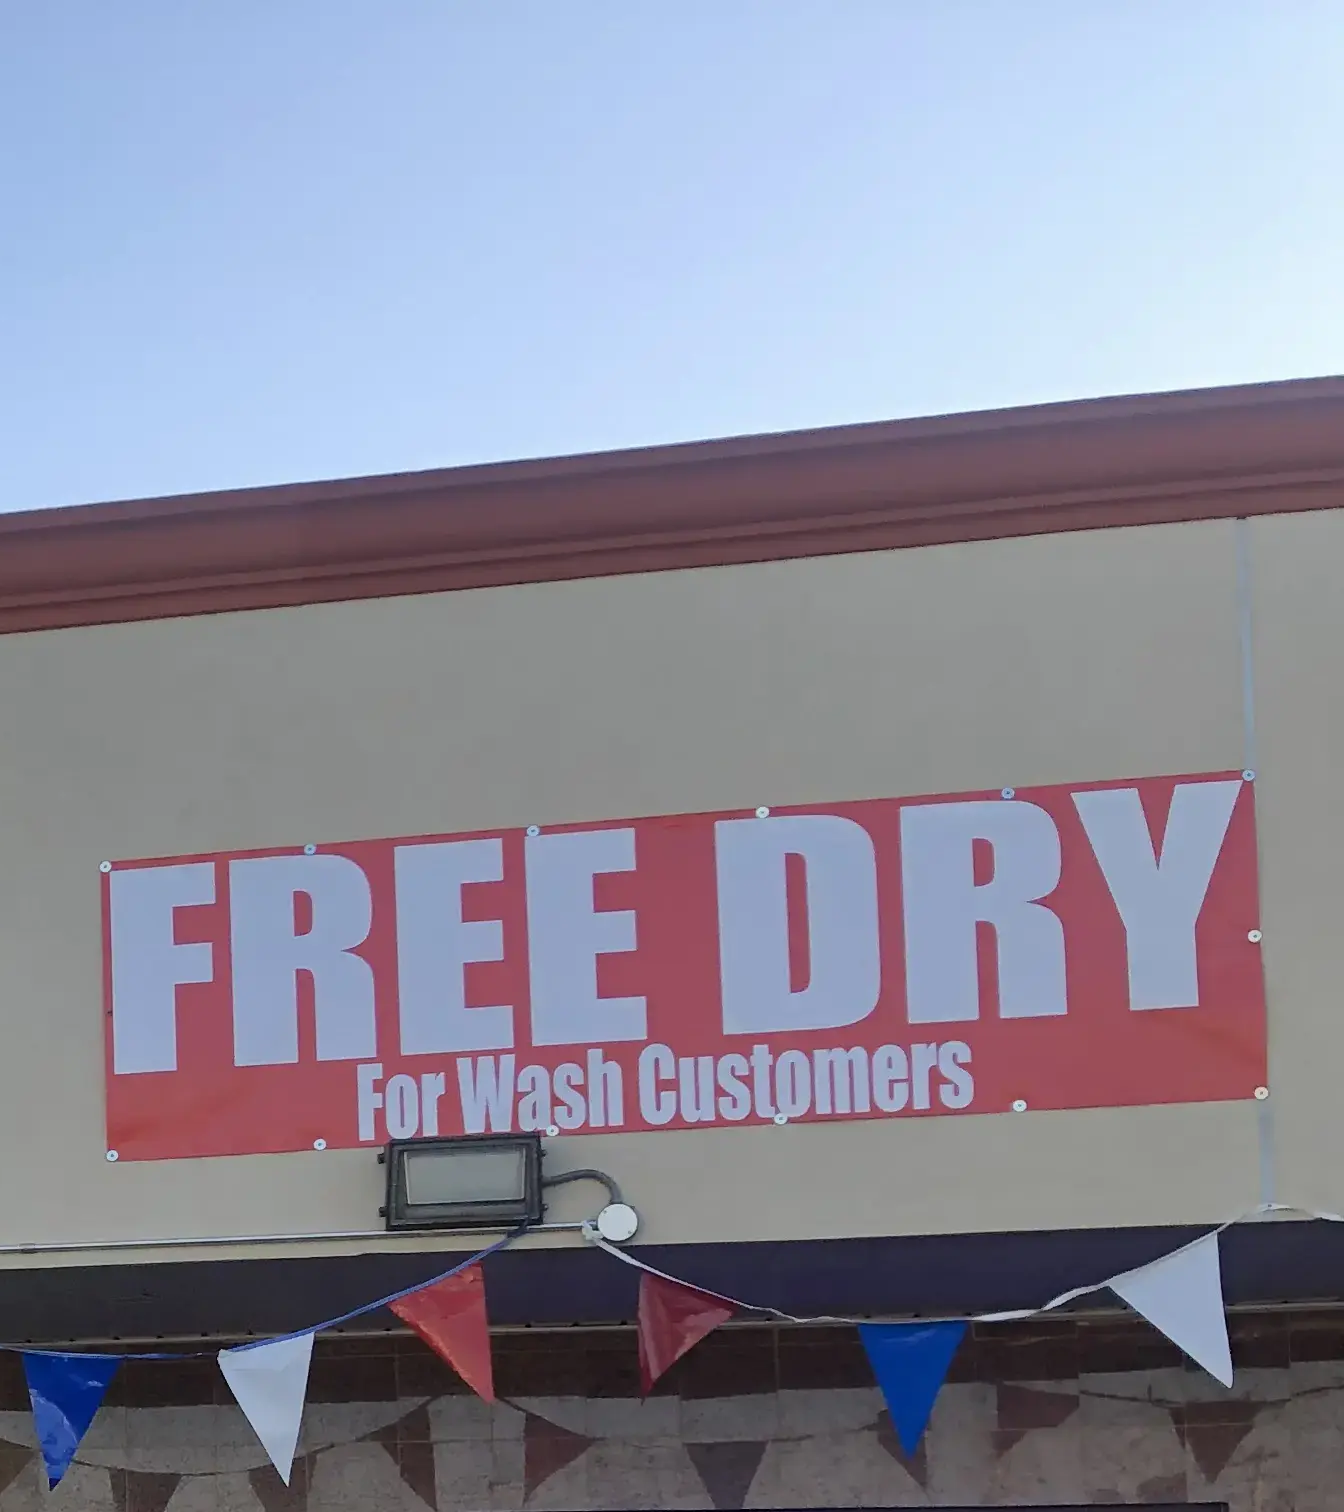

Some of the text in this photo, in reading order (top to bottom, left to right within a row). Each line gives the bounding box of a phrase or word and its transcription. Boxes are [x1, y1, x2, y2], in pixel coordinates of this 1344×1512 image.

[109, 779, 1244, 1075] FREE DRY
[357, 1040, 974, 1141] For Wash Customers
